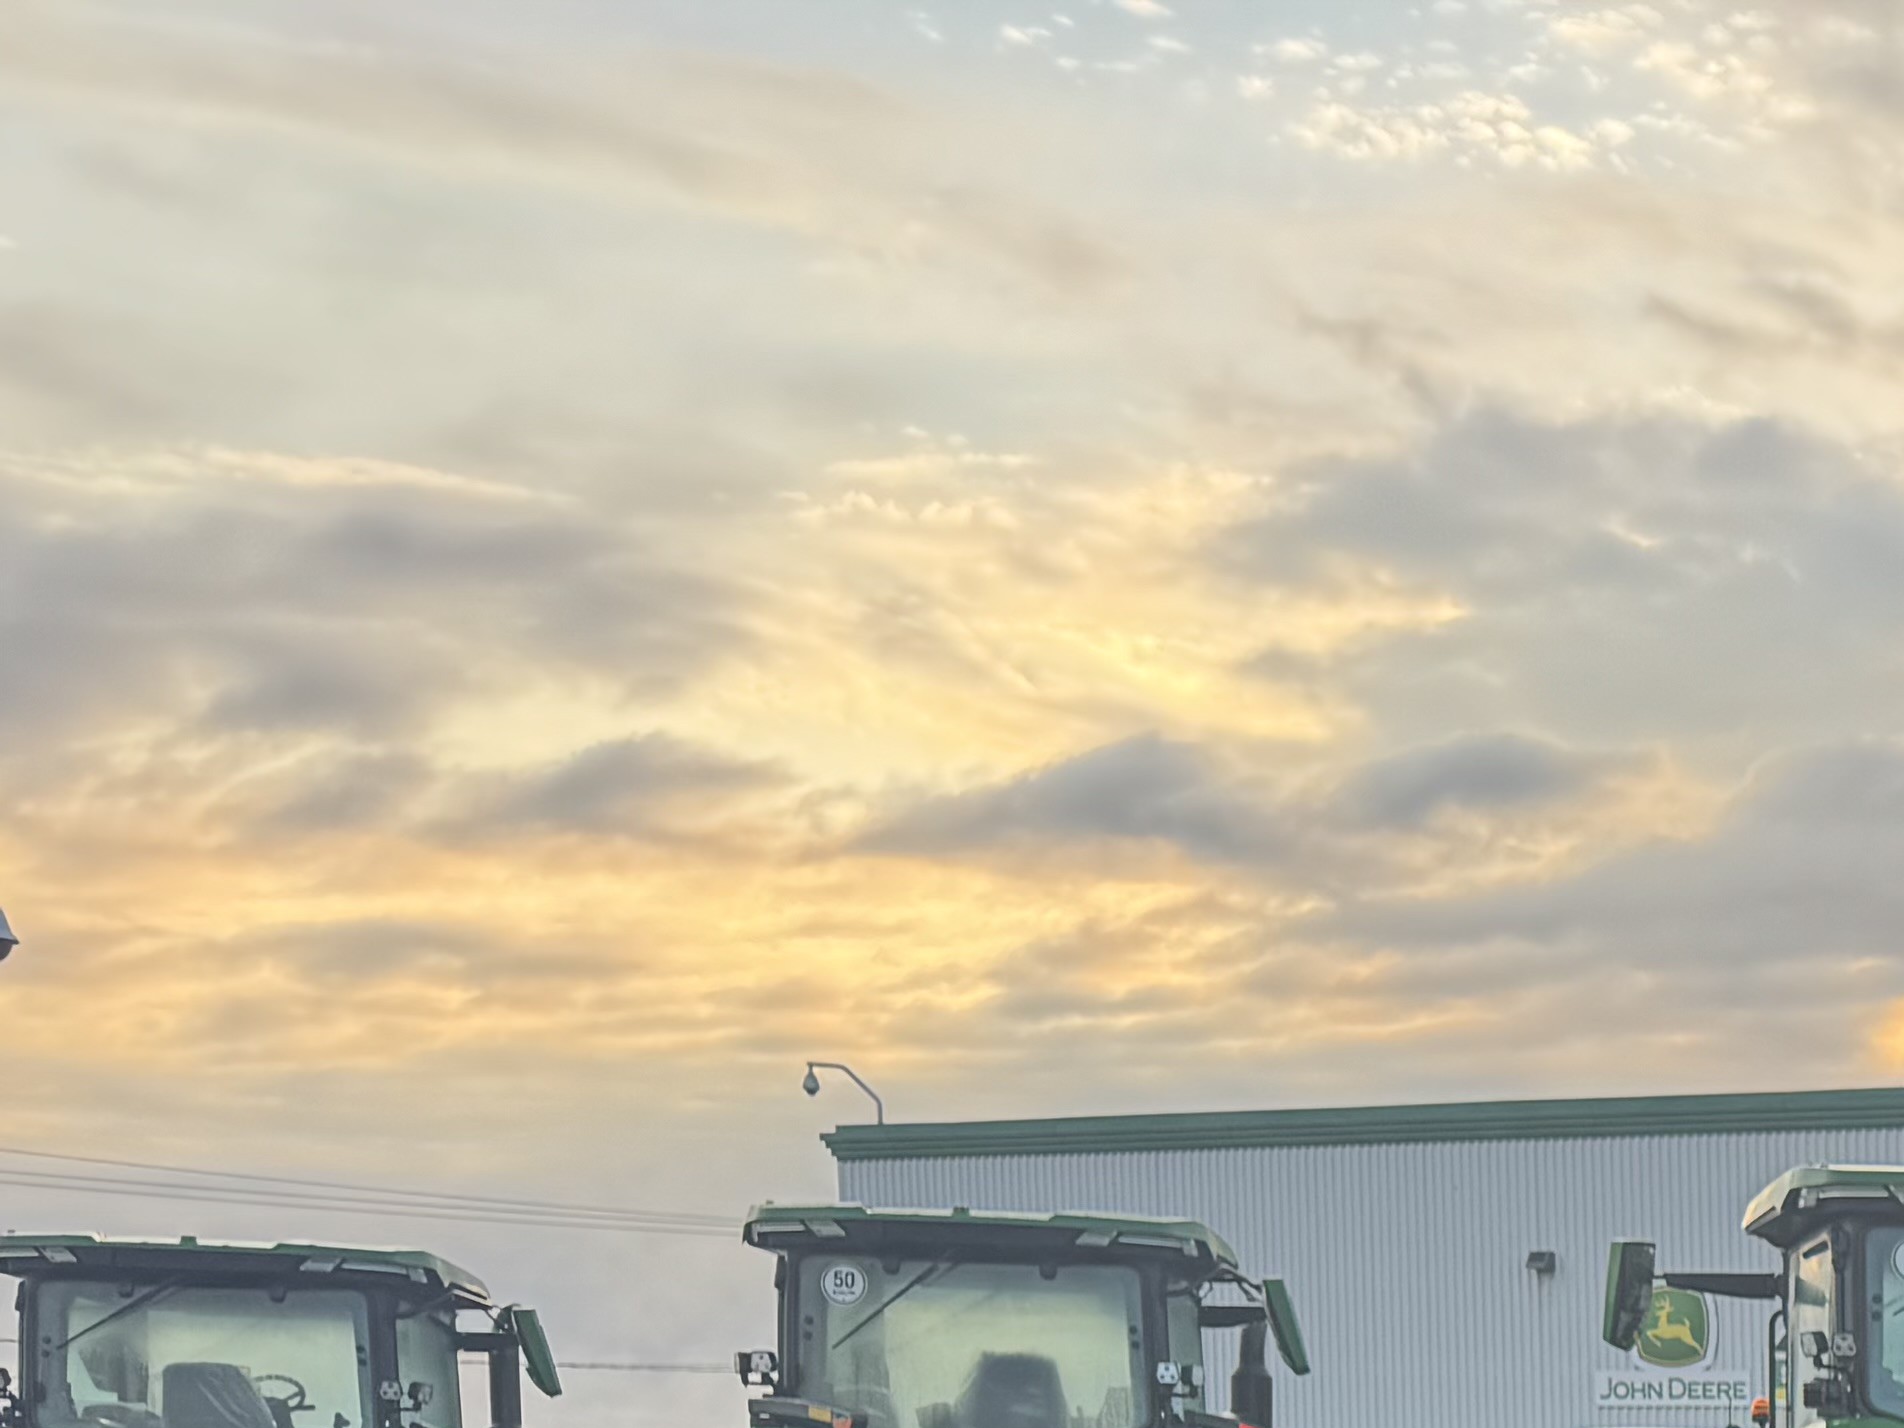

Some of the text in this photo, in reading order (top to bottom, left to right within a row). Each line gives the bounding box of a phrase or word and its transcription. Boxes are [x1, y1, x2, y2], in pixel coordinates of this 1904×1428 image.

[833, 1269, 855, 1289] 50
[1600, 1377, 1746, 1400] JOHN DEERE
